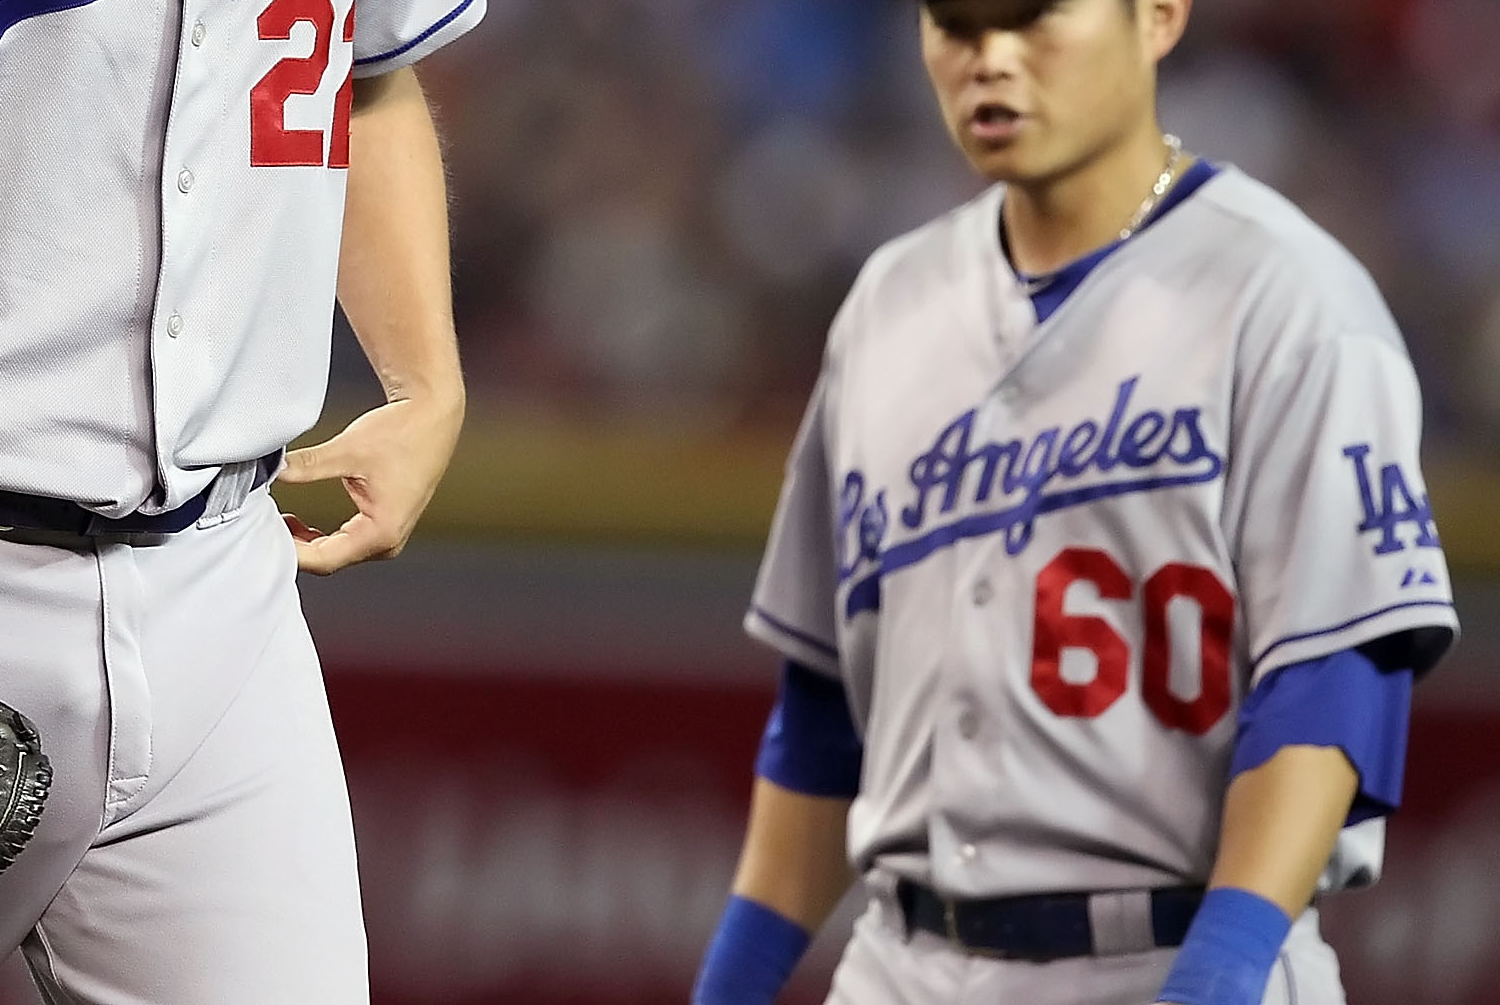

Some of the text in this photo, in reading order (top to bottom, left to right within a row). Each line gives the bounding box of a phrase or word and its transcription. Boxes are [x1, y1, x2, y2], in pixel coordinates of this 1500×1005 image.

[902, 375, 1213, 556] Angeles
[1343, 444, 1441, 555] LA
[1029, 547, 1236, 737] 60
